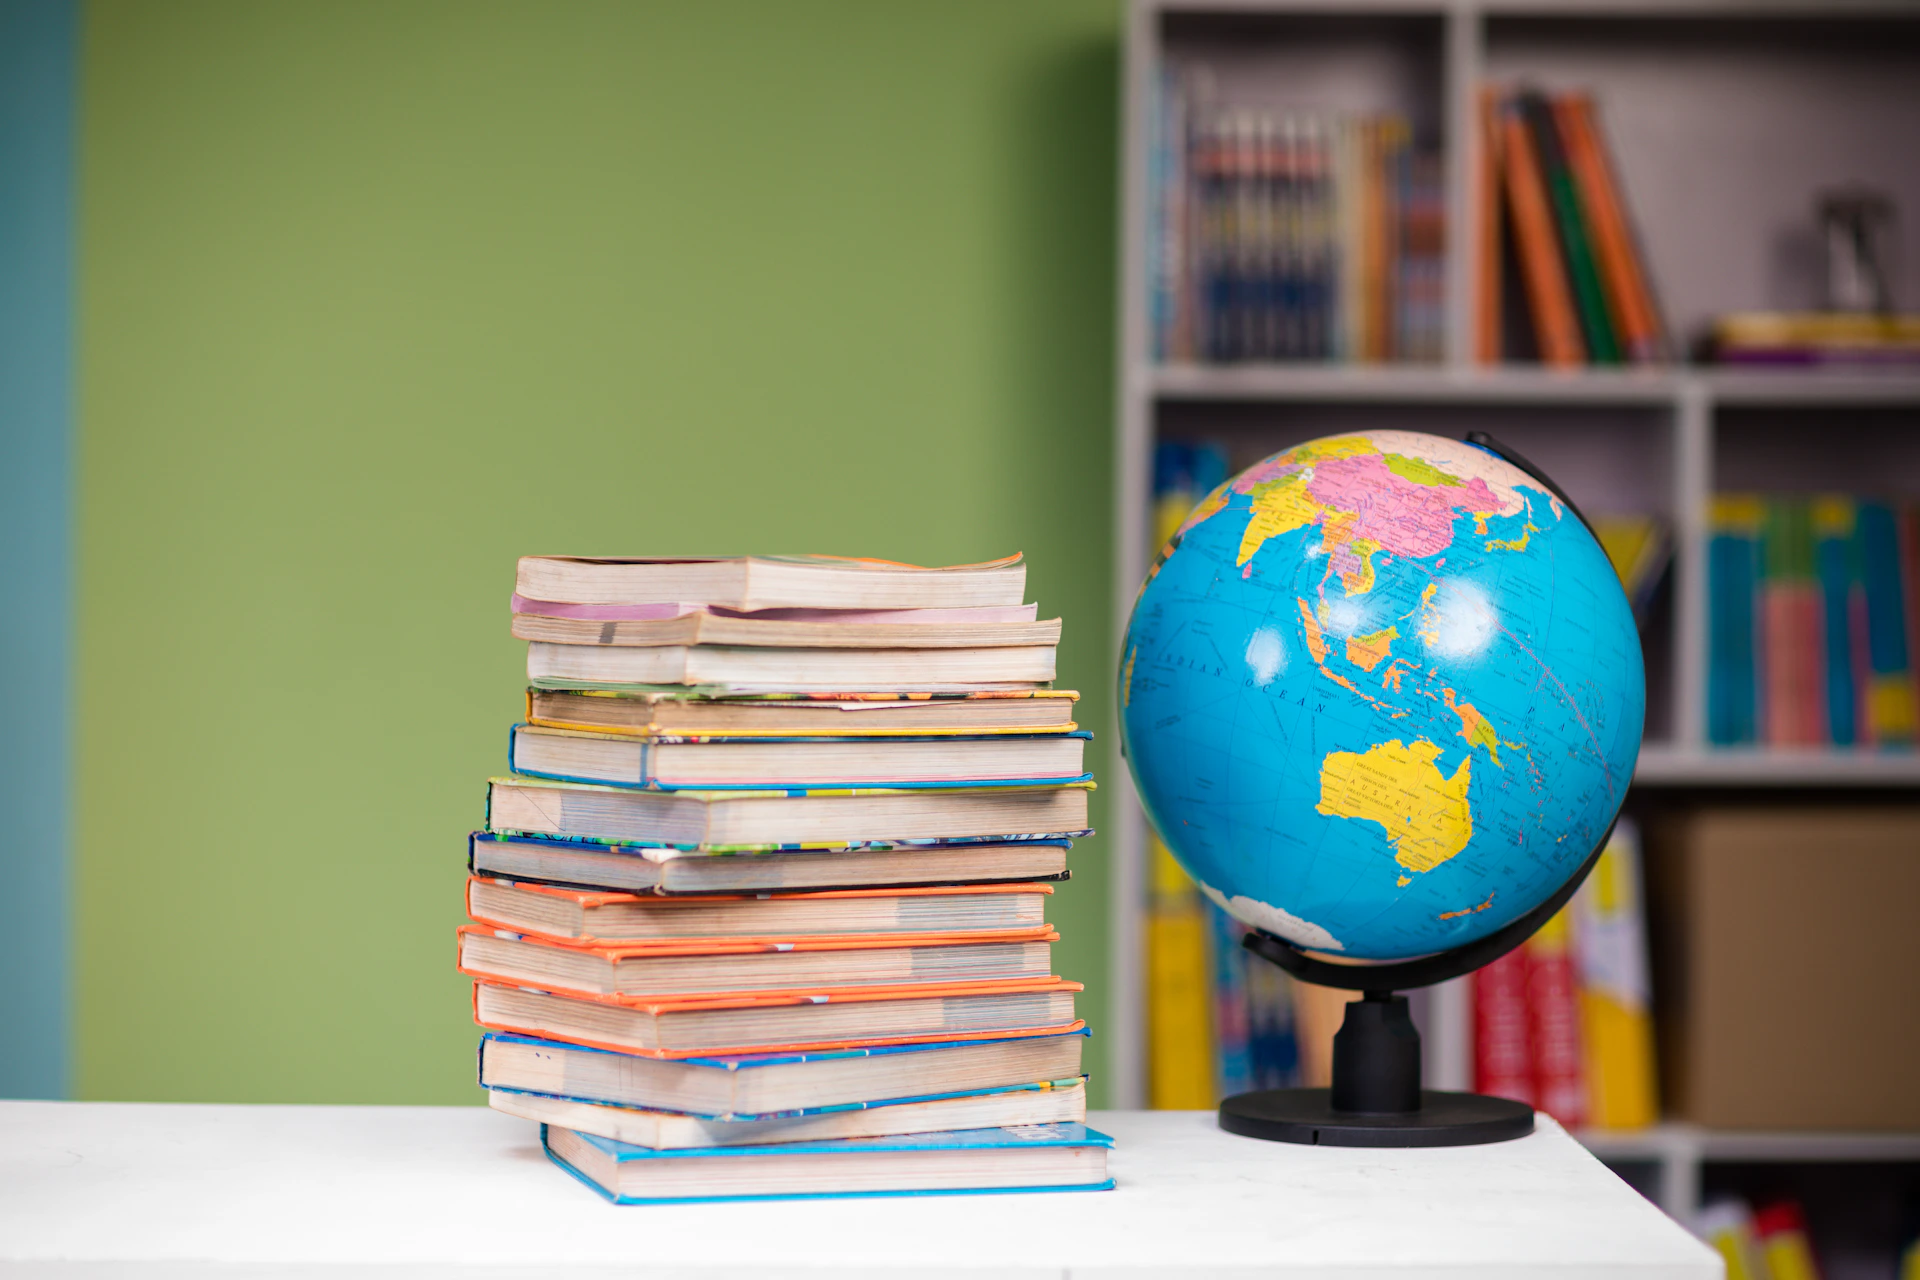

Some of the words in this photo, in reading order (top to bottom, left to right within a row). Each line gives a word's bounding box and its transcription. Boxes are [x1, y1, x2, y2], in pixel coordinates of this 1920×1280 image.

[1158, 653, 1223, 676] INDIAN
[1245, 678, 1326, 713] OCEAN
[1356, 762, 1372, 772] GREAT
[1346, 787, 1361, 796] GREAT
[1361, 793, 1383, 806] VICTORIA
[1350, 779, 1441, 824] AUSTRALIA
